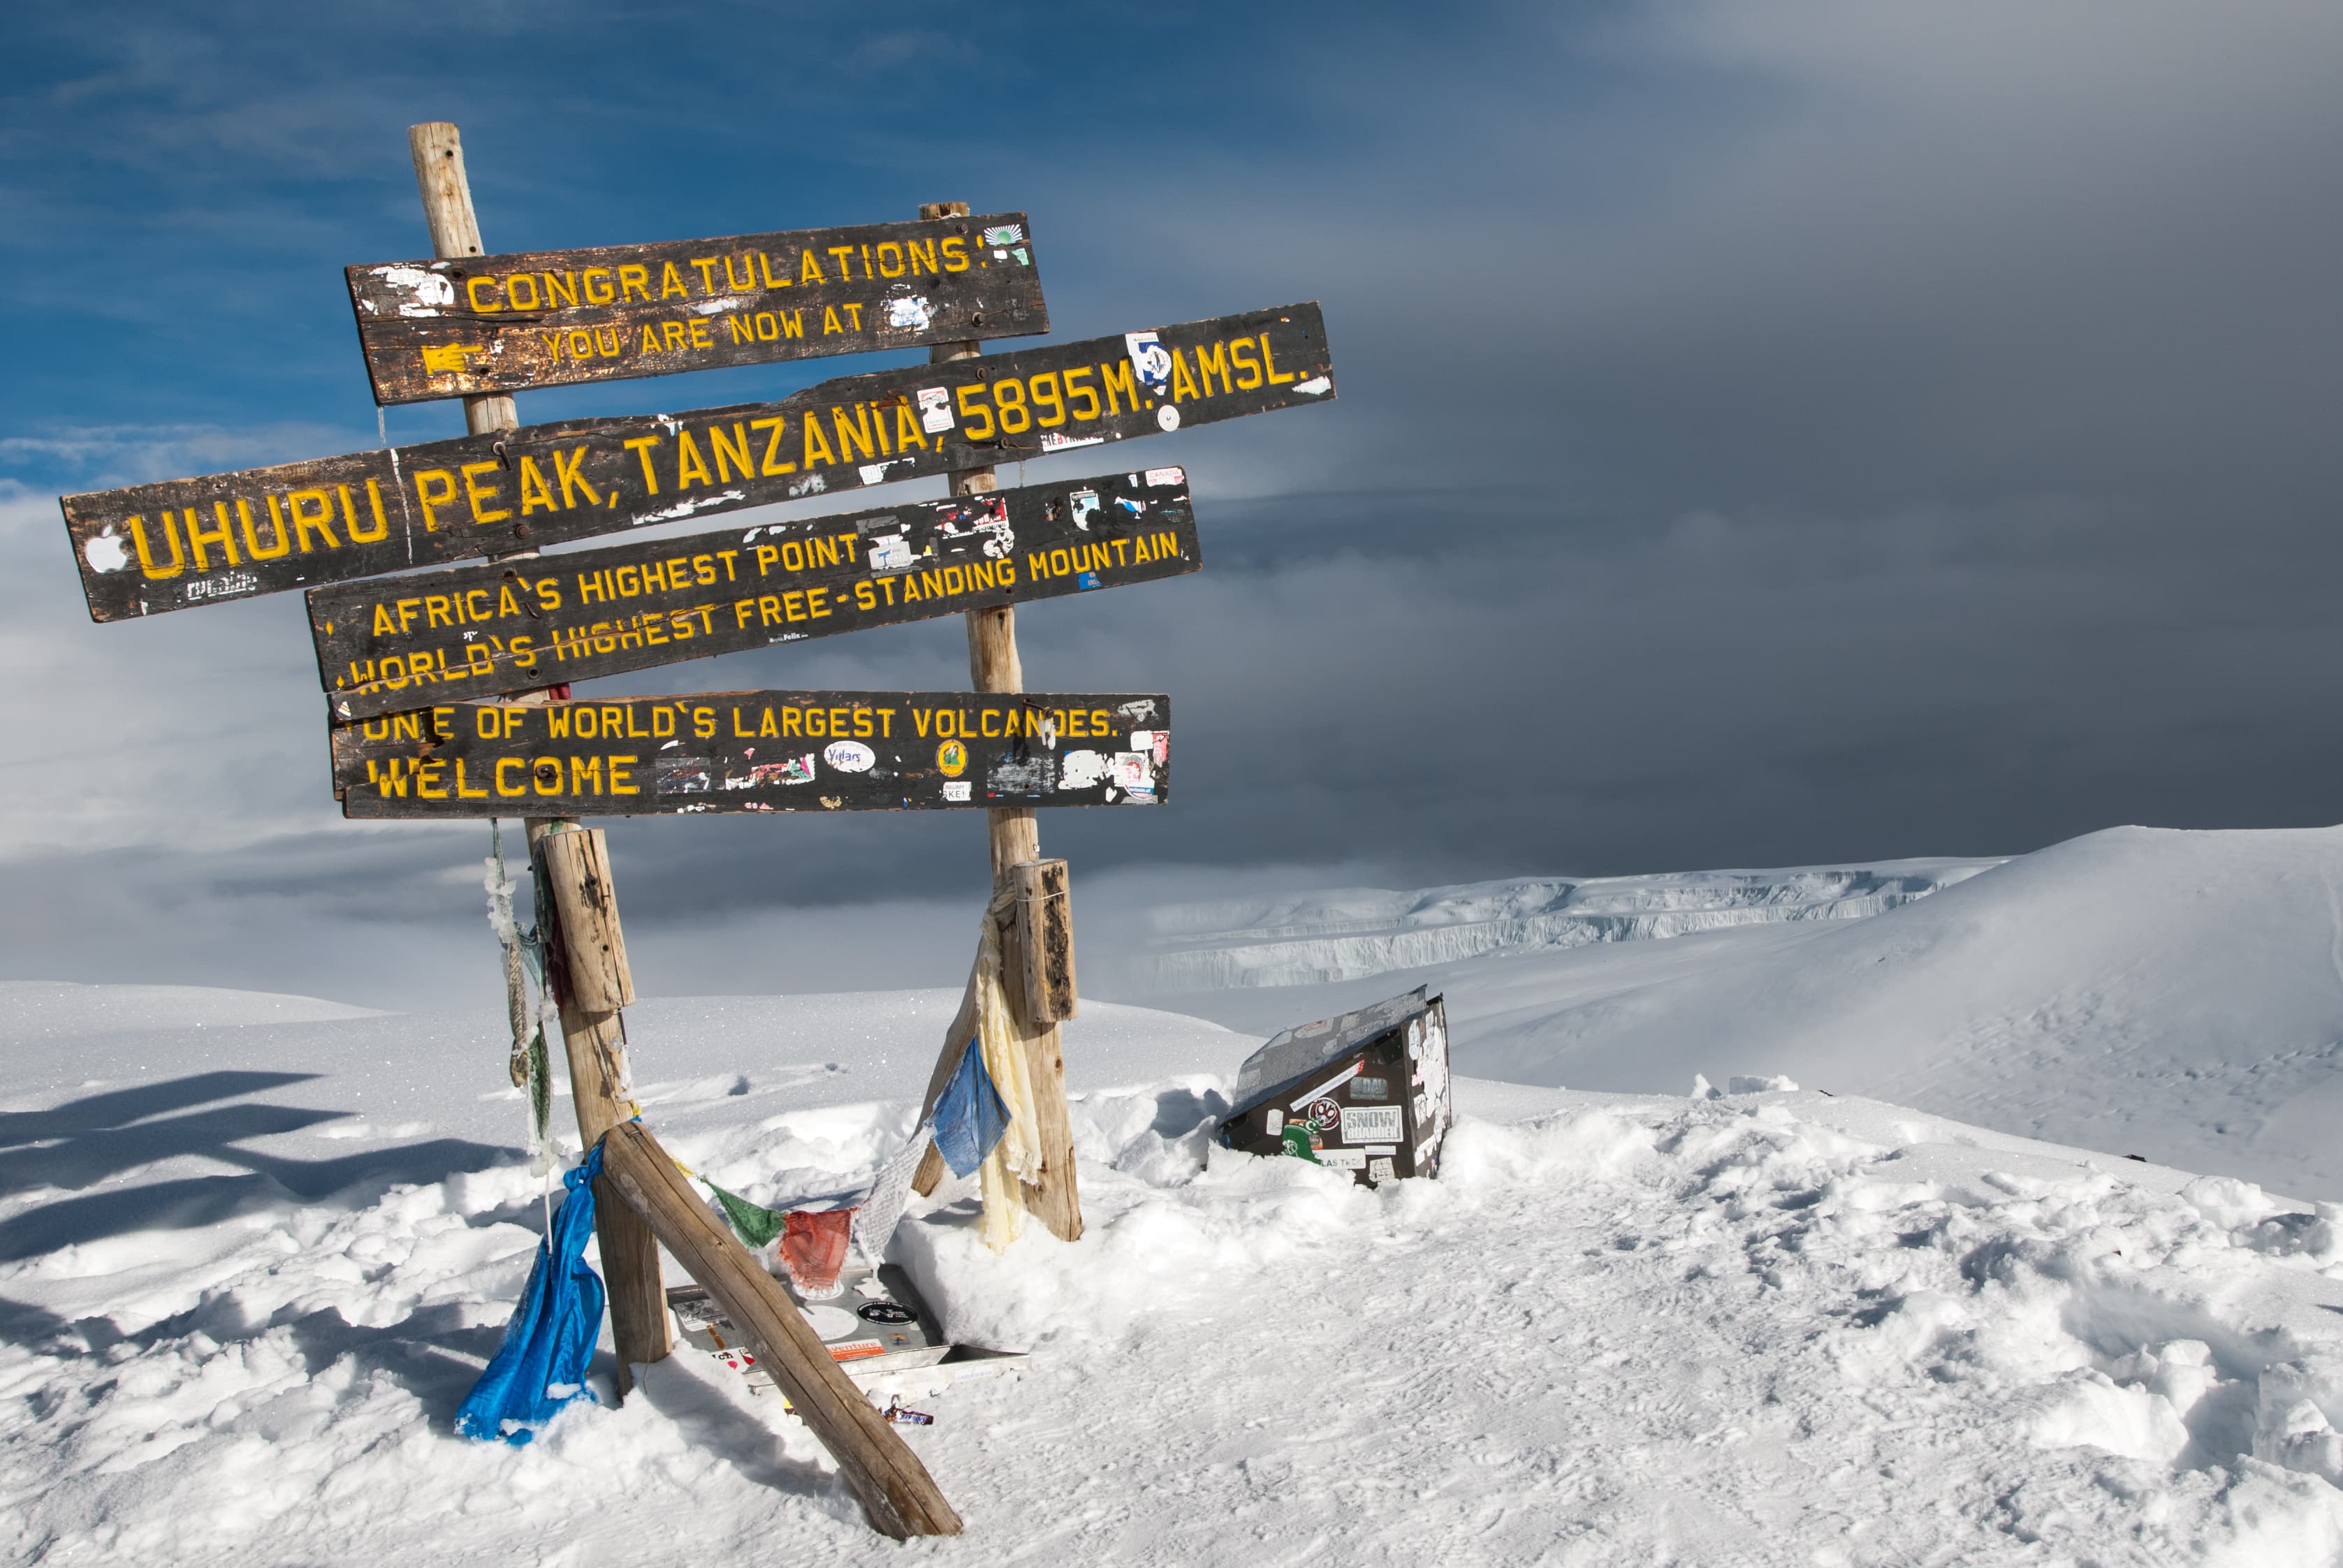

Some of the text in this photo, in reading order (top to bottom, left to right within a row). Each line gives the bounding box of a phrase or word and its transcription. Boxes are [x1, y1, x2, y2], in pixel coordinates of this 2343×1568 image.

[466, 235, 988, 313] CONGRATULATIONS!
[541, 302, 863, 363] YOU ARE NOW AT
[128, 335, 1308, 580] UHURU PEAK, TANZANIA, 5895M. AMSL.
[577, 549, 738, 603] HIGHEST
[756, 532, 858, 577] POINT
[551, 603, 716, 661] HIGHEST
[734, 557, 1016, 630] FREE-STANDING
[363, 706, 455, 740] ONE
[476, 706, 527, 739] OF
[732, 706, 896, 738] LARGEST
[366, 754, 640, 799] WELCOME
[1347, 1112, 1396, 1129] SNOW
